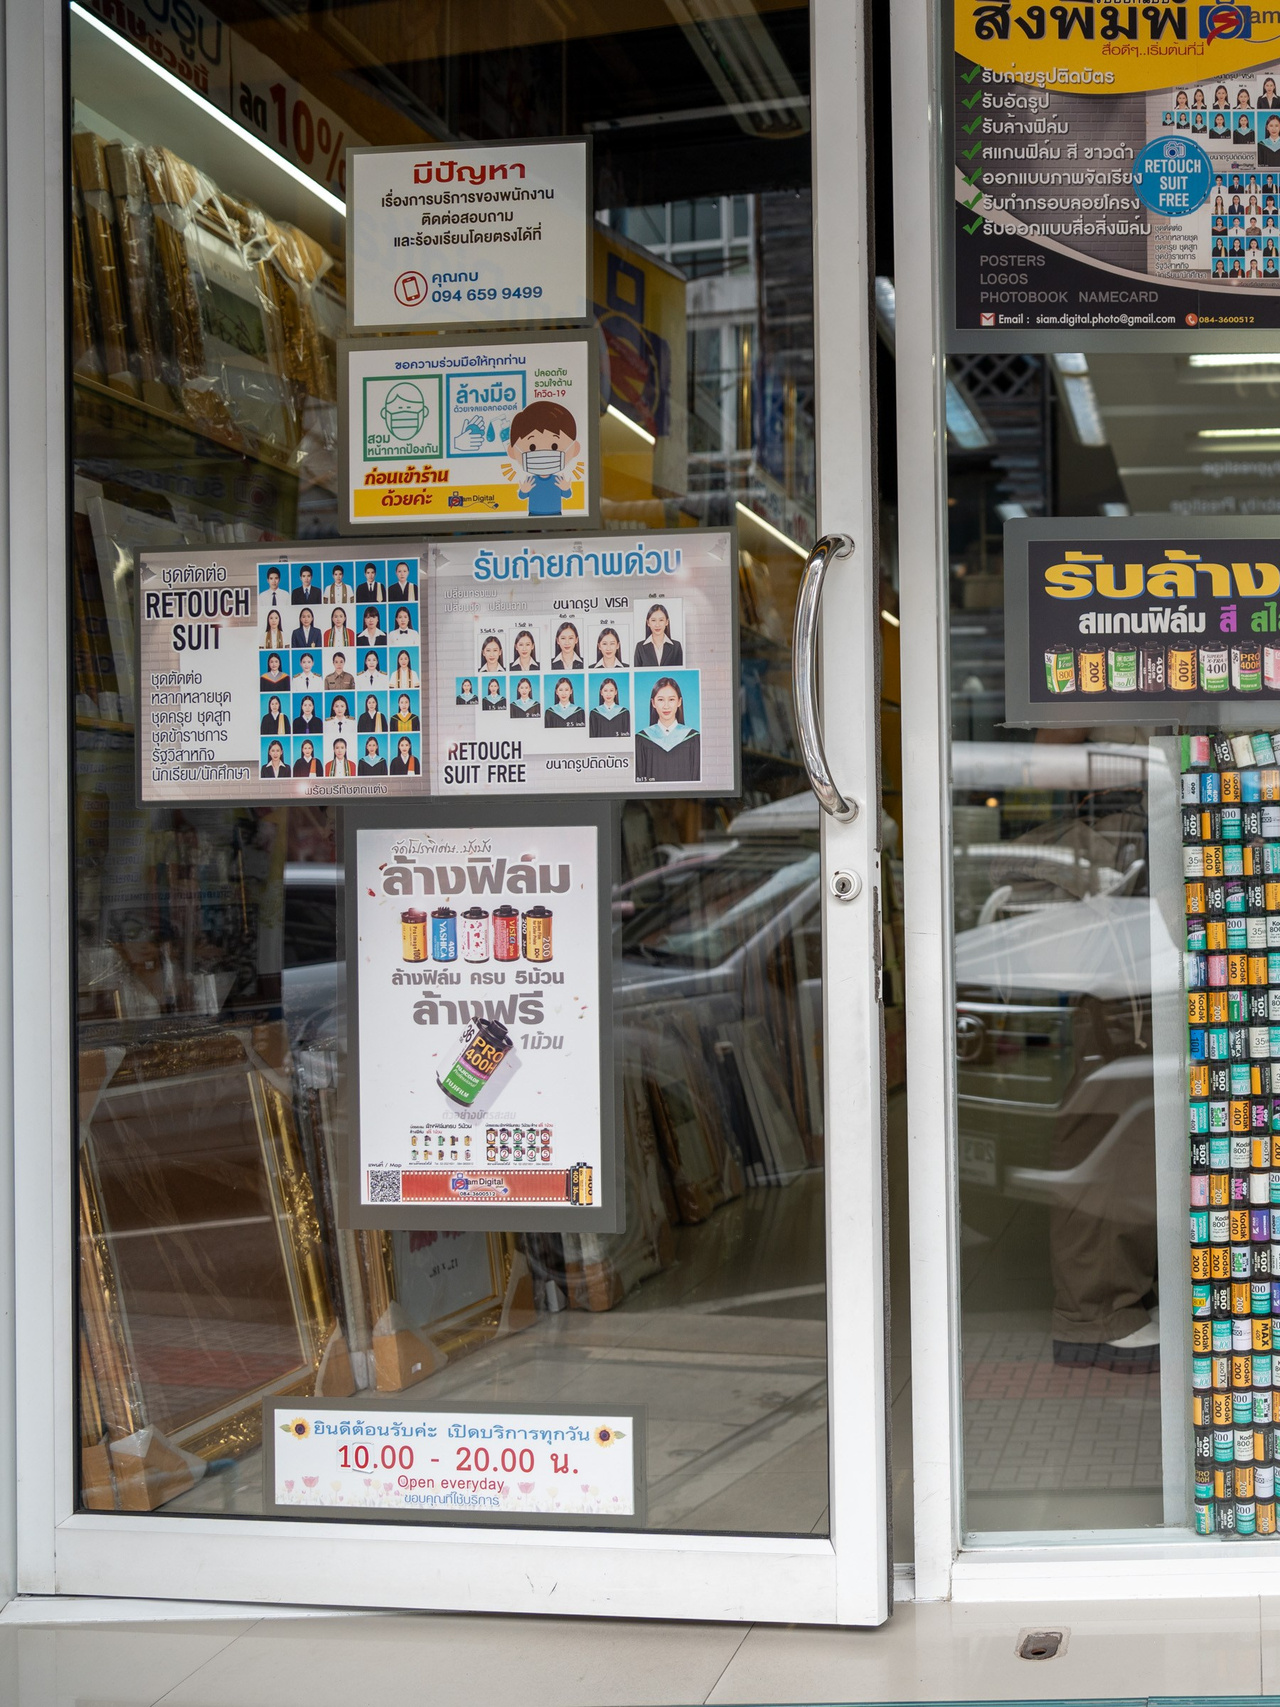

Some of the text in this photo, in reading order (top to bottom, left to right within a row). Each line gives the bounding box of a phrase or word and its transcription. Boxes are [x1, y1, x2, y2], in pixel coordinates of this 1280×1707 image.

[982, 63, 1114, 88] รับถ่ายรูปติดบัตร
[982, 92, 1049, 113] รับอัดรูป
[982, 113, 1069, 134] รับล้างฟิล์ม
[982, 143, 1134, 160] สแกนฟิล์ม สี ขาวดำ
[414, 160, 526, 185] มีปัญหา
[1145, 158, 1201, 174] RETOUCH
[982, 169, 1143, 186] ออกแบบภาพจัดเรียง
[1160, 175, 1187, 191] SUIT
[381, 188, 554, 208] เรื่องการบริการของพนักงาน
[983, 193, 1140, 210] รับทำกรอบลอยโครง
[1159, 192, 1189, 208] FREE
[421, 210, 514, 225] ติดต่อสอบถาม
[394, 222, 542, 247] และร้องเรียนโดยตรงได้ที่
[980, 255, 1045, 267] POSTERS
[432, 271, 479, 288] คุณกบ
[980, 274, 1028, 285] LOGOS
[432, 286, 543, 302] 094 659 9499
[980, 291, 1158, 303] PHOTOBOOK NAMECARD
[998, 314, 1175, 326] Email siam.digital.photo@gmail.com
[1199, 316, 1254, 324] 084-3600512
[395, 355, 526, 370] ขอความร่วมมือให้ทุกท่าน
[534, 368, 568, 378] ปลอดภัย
[534, 377, 573, 388] รวมใจต้าน
[456, 382, 516, 404] ล้างมือ
[534, 389, 566, 398] โควิด-19
[367, 433, 390, 444] สวม
[367, 443, 439, 456] หน้ากากป้องกัน
[364, 466, 449, 486] ก่อนเข้าร้าน
[381, 489, 432, 507] ด้วยค่ะ
[163, 563, 227, 588] ชุดตัดต่อ
[146, 589, 249, 619] RETOUCH
[552, 597, 628, 612] ขนาดรูป VISA
[1079, 604, 1206, 634] สแกนฟิล์ม
[1219, 604, 1237, 632] สี
[172, 624, 222, 650] SUIT
[151, 670, 202, 689] ชุดตัดต่อ
[151, 690, 231, 709] หลากหลายชุด
[152, 712, 231, 727] ชุดครุย ชุดสูท
[152, 729, 227, 746] ชุดข้าราชการ
[152, 748, 214, 764] รัฐวิสาหกิจ
[448, 741, 522, 760] RETOUCH
[546, 757, 629, 772] ขนาดรูปติดบัตร
[152, 766, 250, 782] นักเรียน/นักศึกษา
[444, 764, 526, 784] SUIT FREE
[382, 854, 571, 896] ล้างฟิล์ม
[439, 921, 447, 958] YASHICA
[391, 968, 565, 985] ล้างฟิล์ม ครบ 5ม้วน
[413, 990, 545, 1025] ล้างฟรี
[520, 1031, 564, 1050] 1ม้วน
[479, 1178, 504, 1187] Digital
[313, 1420, 590, 1445] ยินดีต้อนรับค่ะ เปิดบริการทุกวัน
[338, 1445, 578, 1474] 10.00 20.00 น.
[397, 1474, 505, 1493] Open everyday
[405, 1491, 499, 1507] ขอบคุณที่ใช้บริการ
